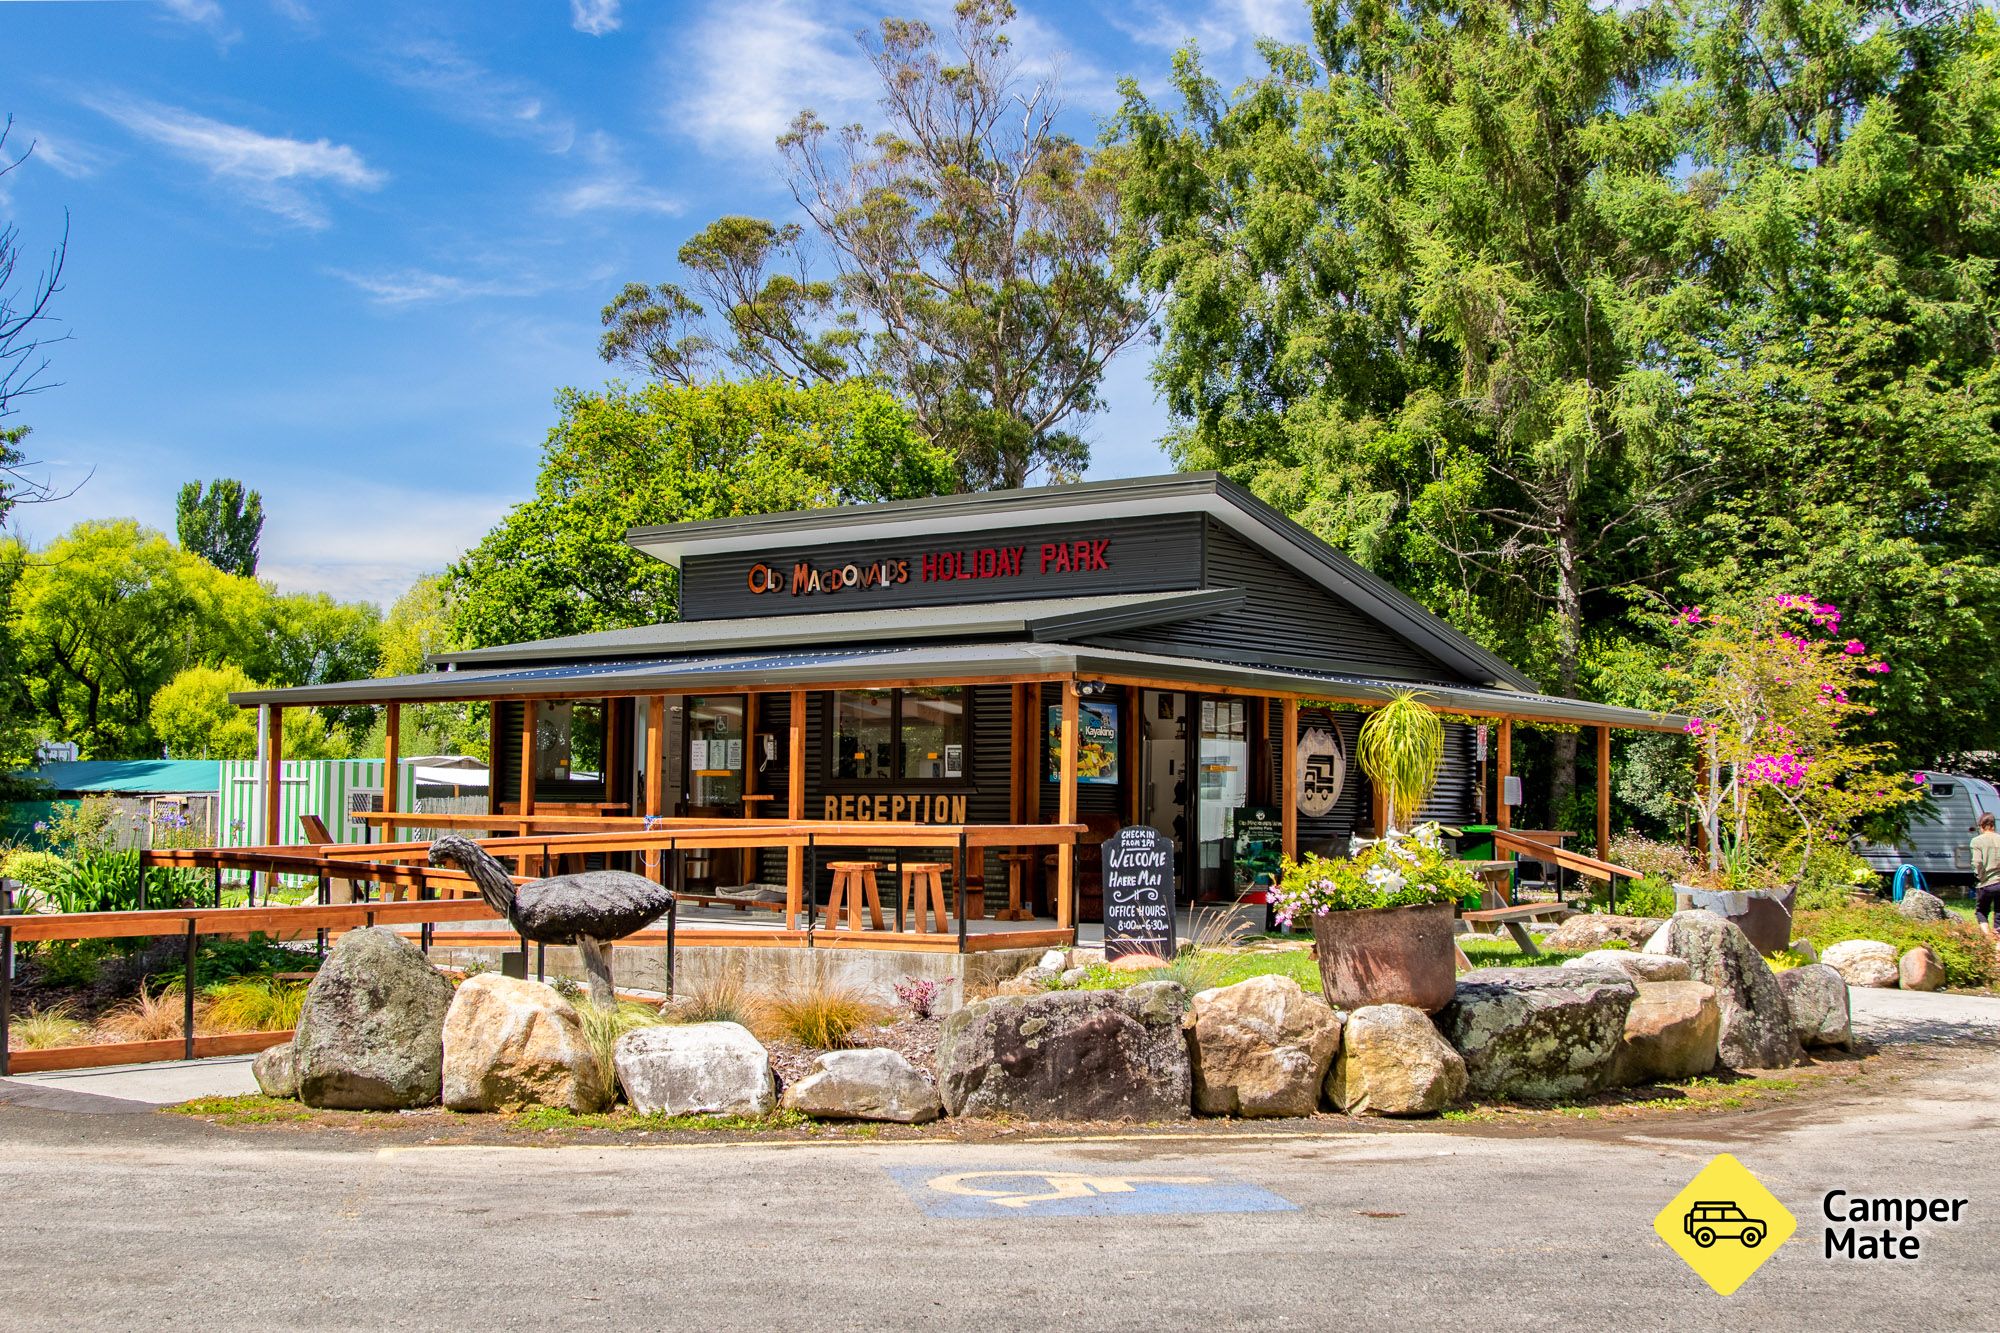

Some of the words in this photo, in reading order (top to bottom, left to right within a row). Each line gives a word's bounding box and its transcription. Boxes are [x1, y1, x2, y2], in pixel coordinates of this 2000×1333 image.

[748, 563, 784, 594] OLD
[791, 559, 908, 596] MACDONALDS
[921, 545, 1025, 583] HOLIDAY
[1039, 538, 1111, 575] PARK
[1085, 726, 1115, 739] Kayaking
[824, 795, 967, 824] RECEPTION
[1121, 839, 1141, 847] FROM
[1141, 839, 1155, 847] 1PM
[1110, 848, 1167, 869] WELCOME
[1137, 870, 1162, 886] MAI
[1108, 905, 1136, 917] OFFICE
[1138, 905, 1167, 917] HOURS
